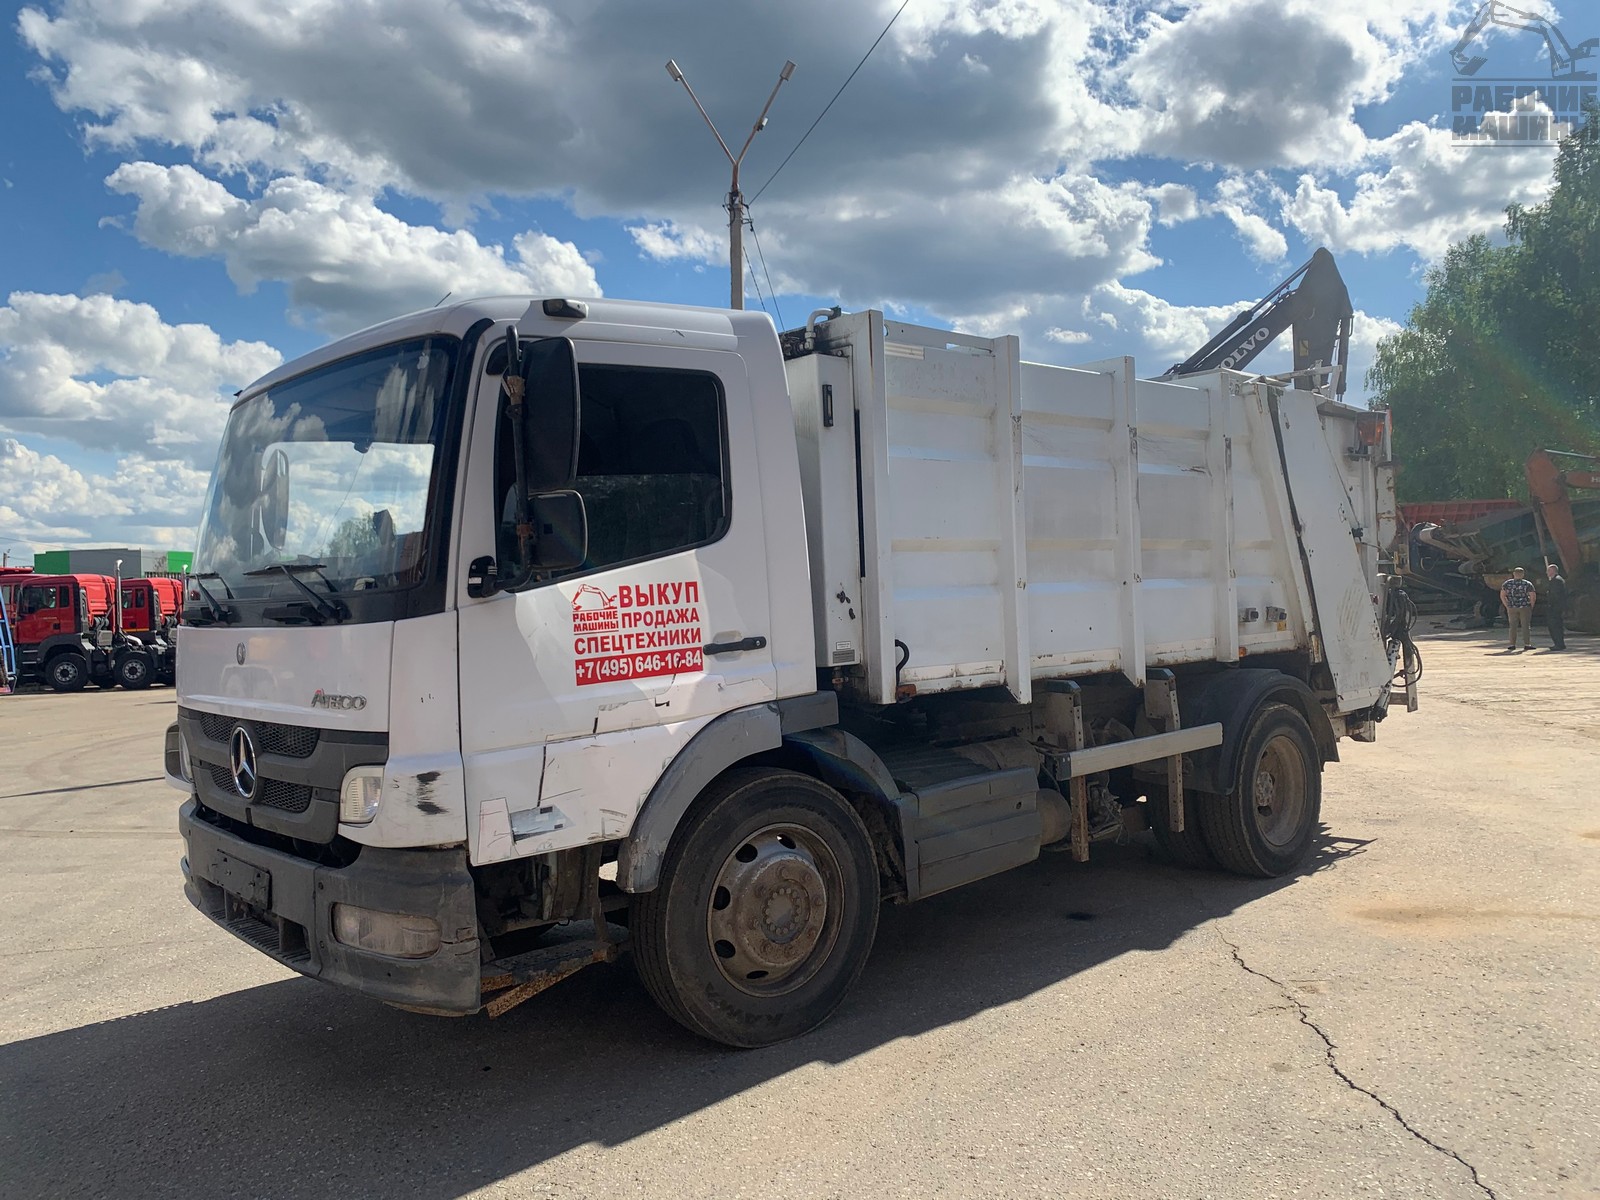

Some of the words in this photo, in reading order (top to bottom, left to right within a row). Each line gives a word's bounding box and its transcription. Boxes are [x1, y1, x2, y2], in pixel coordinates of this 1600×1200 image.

[1215, 327, 1270, 369] OLVO
[618, 581, 699, 608] ВЫКУП
[572, 610, 618, 622] РАБОЧИЕ
[573, 620, 619, 632] МАШИНЫ
[621, 607, 700, 628] ПРОДАЖА
[574, 627, 702, 655] СПЕЦТЕХНИКИ
